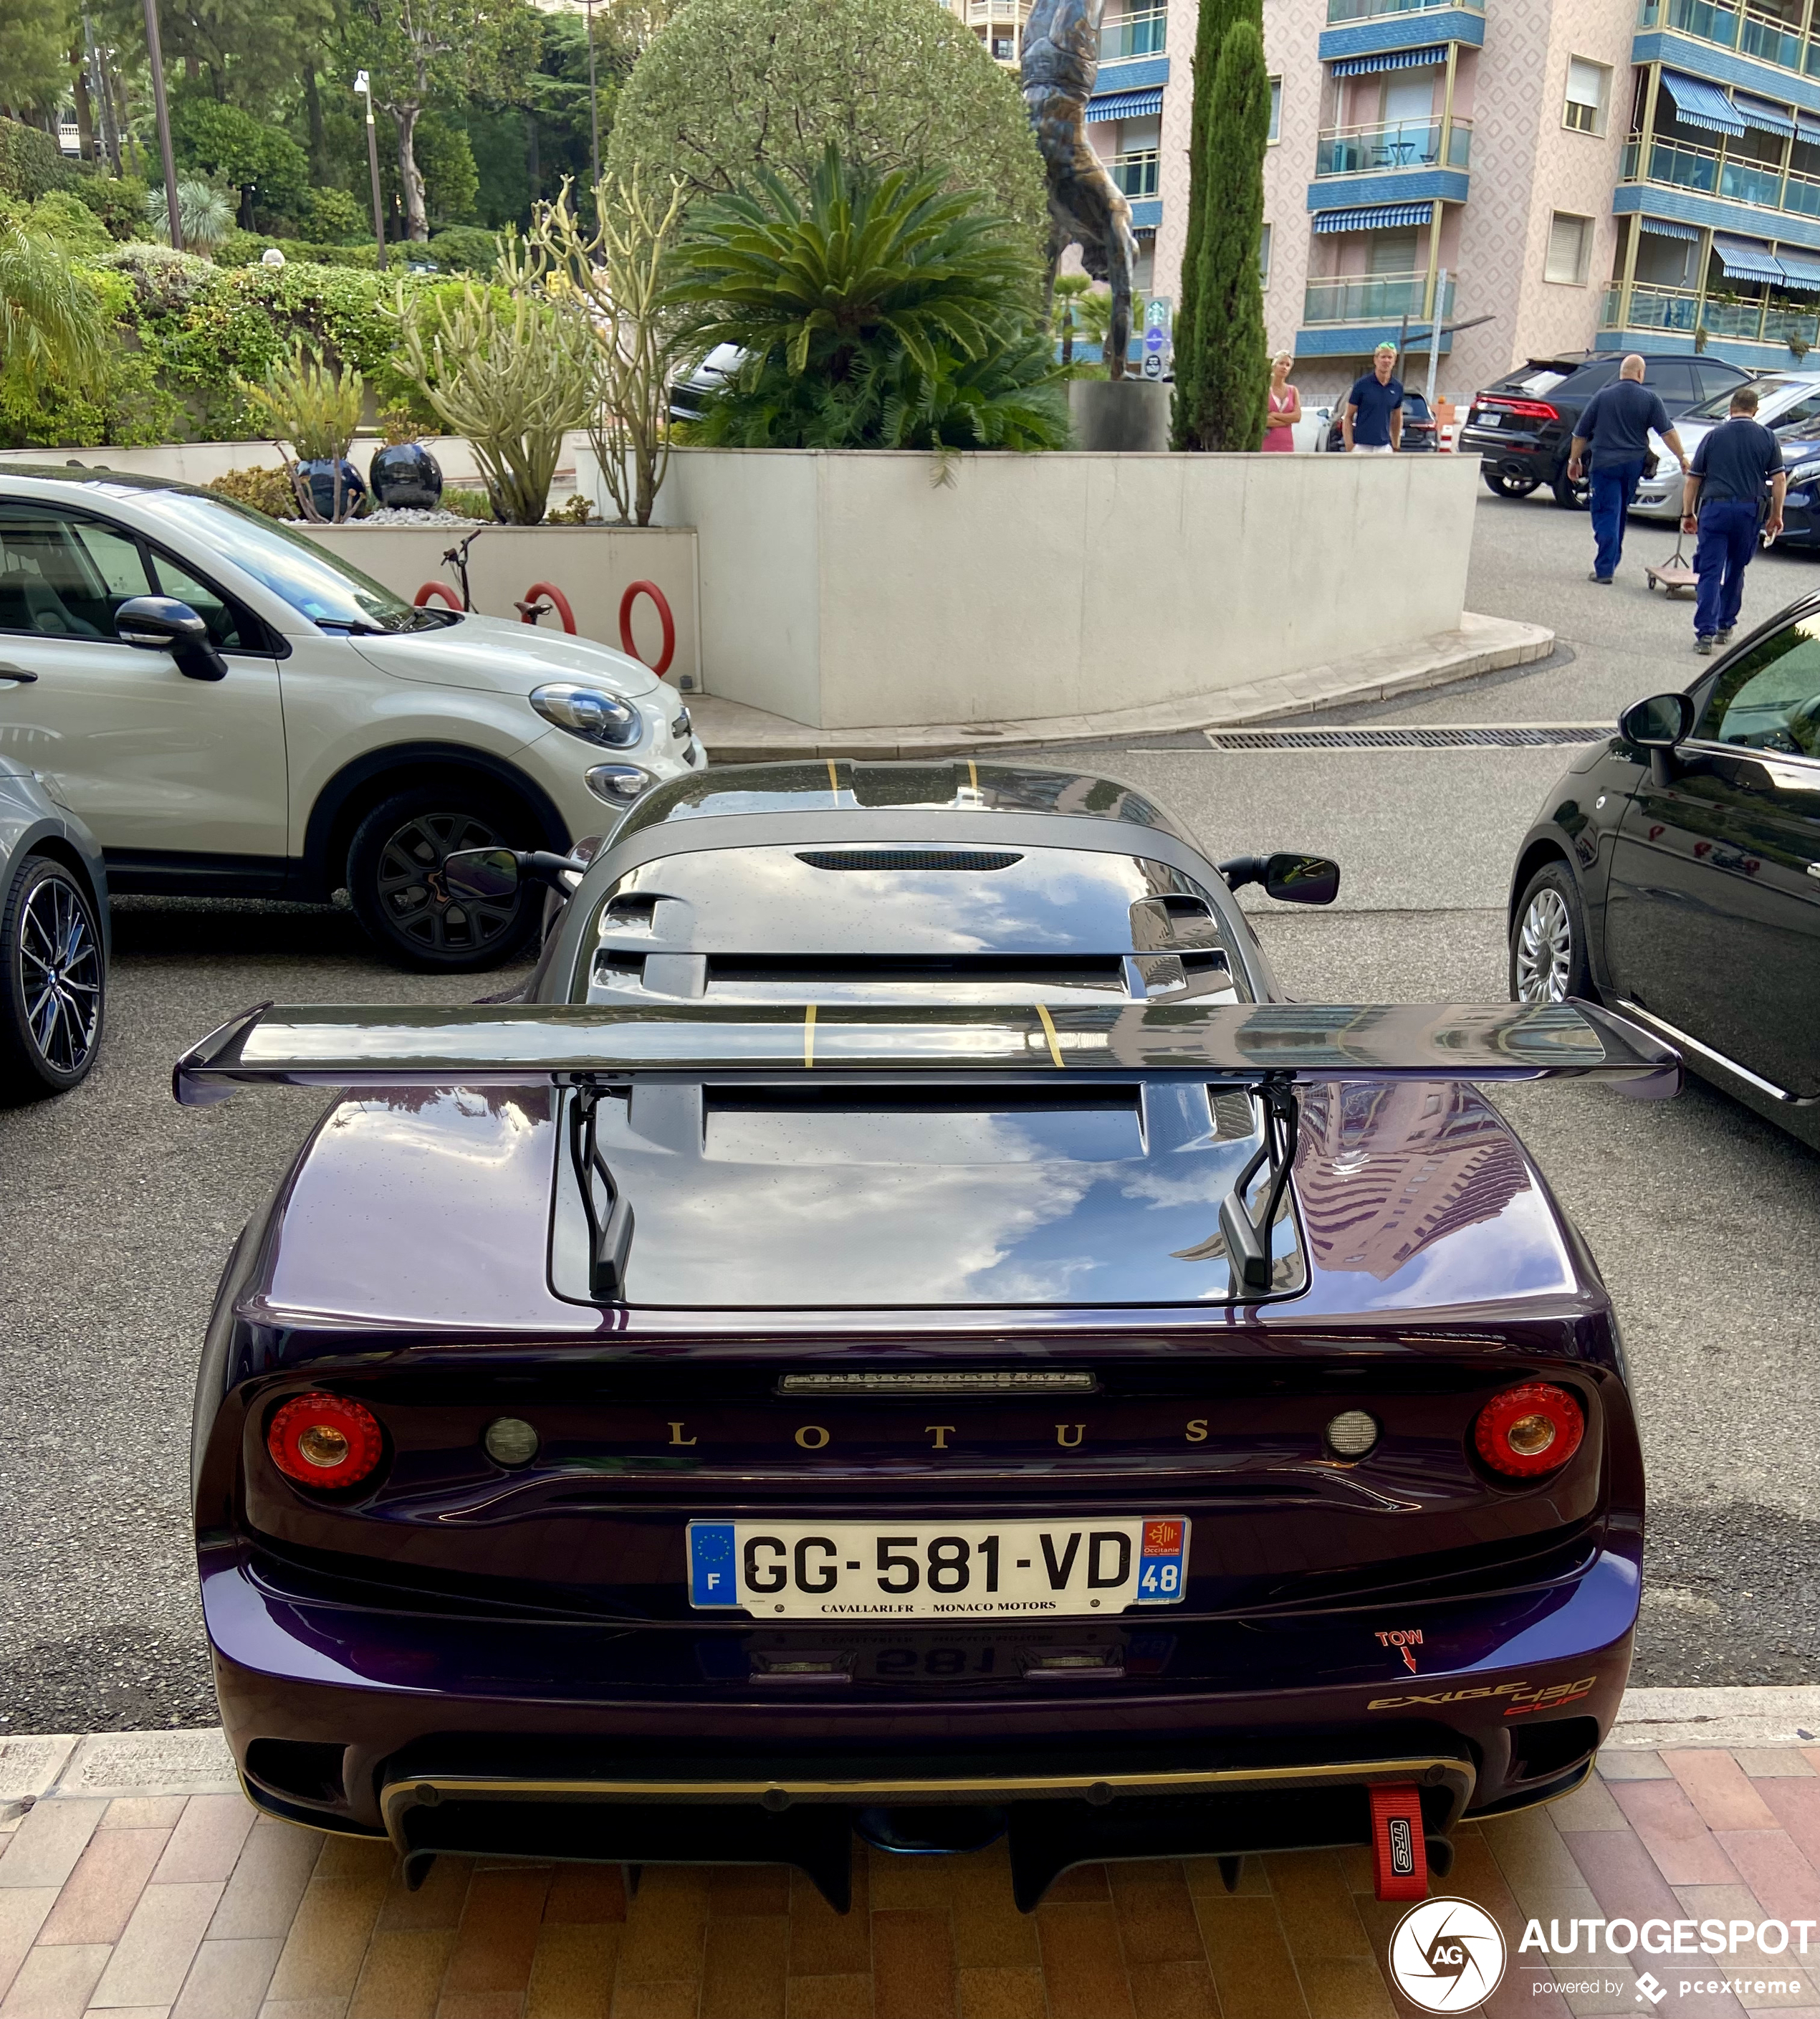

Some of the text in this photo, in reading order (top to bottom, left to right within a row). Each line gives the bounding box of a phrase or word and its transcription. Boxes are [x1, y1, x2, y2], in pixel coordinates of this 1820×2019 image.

[668, 1420, 1208, 1448] LOTUS
[744, 1532, 1131, 1593] GG-581-VD
[707, 1573, 720, 1590] F
[1141, 1565, 1178, 1592] 48
[933, 1603, 994, 1612] MONACO
[997, 1601, 1057, 1610] MOTORS
[1375, 1629, 1424, 1646] TOW
[1367, 1676, 1596, 1710] EXIGE 430
[1503, 1691, 1589, 1716] CUP
[1394, 1823, 1409, 1869] TRS
